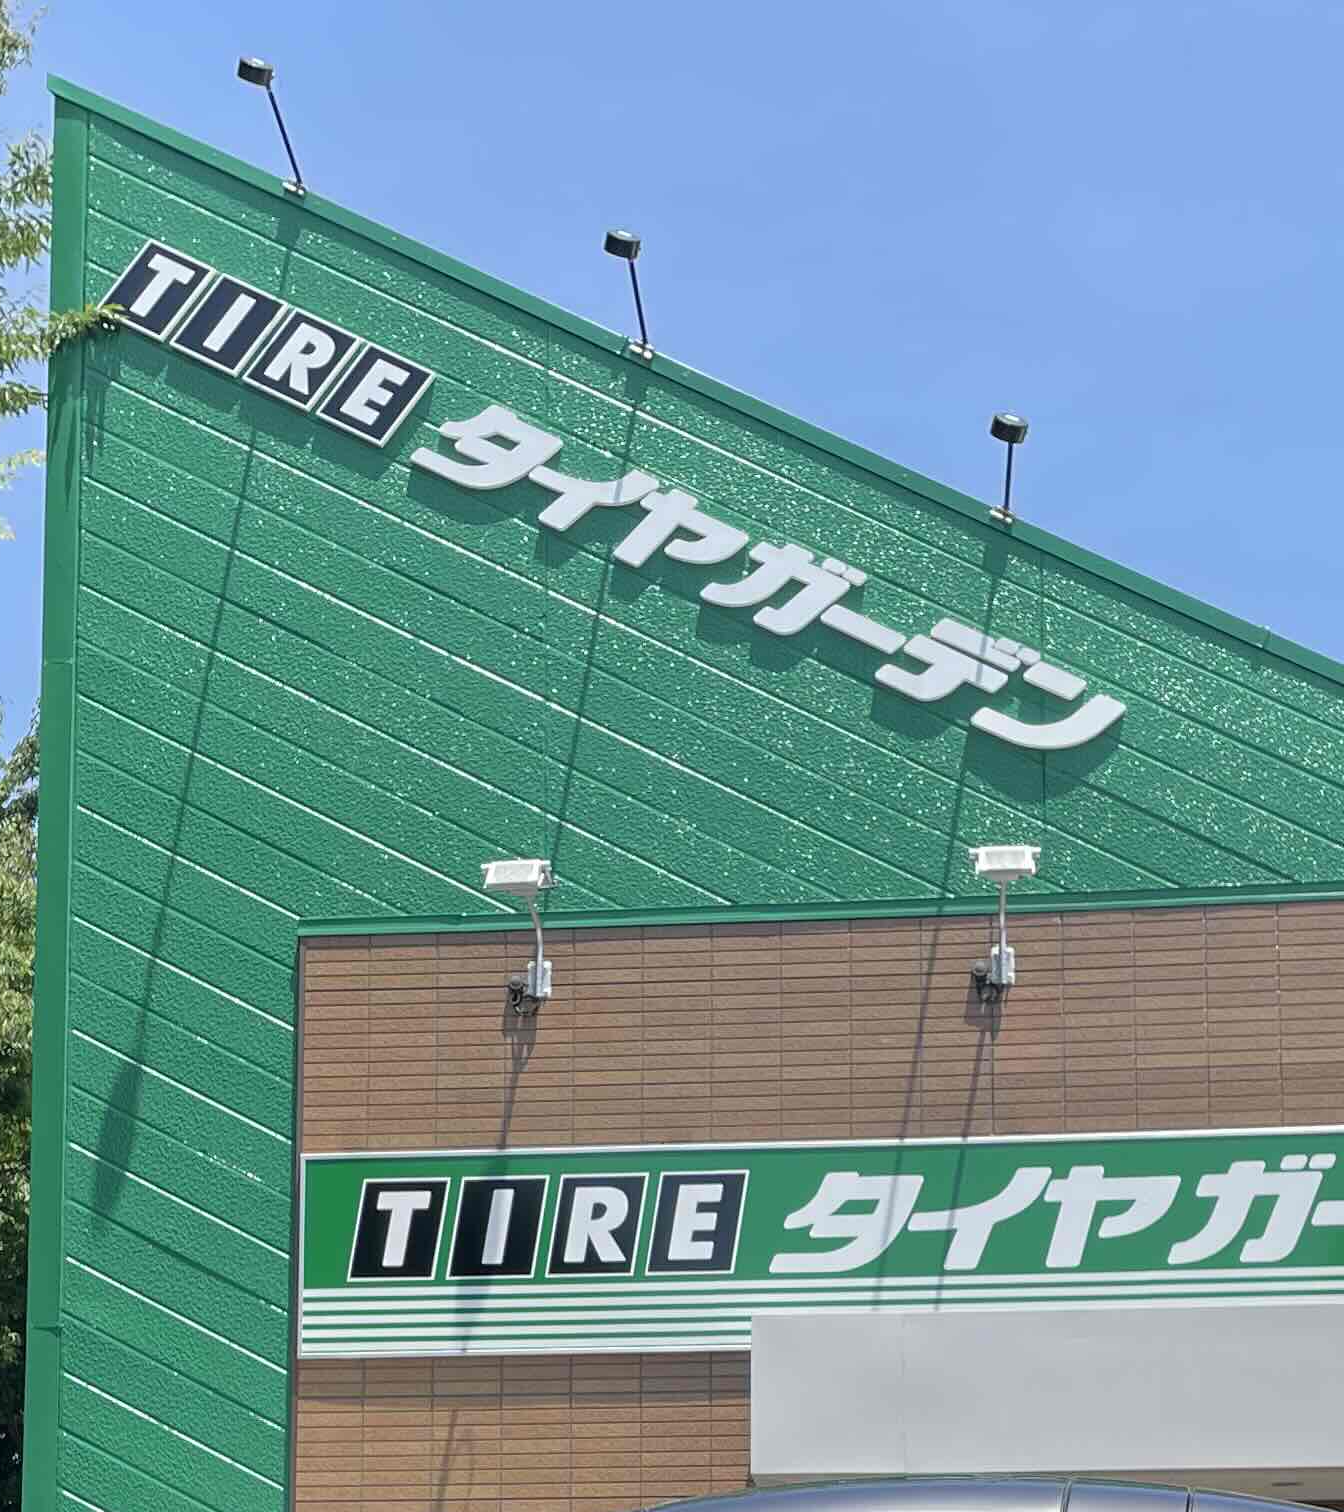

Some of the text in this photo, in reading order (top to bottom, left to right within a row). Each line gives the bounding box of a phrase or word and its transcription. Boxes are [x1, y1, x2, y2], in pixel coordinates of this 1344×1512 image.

[129, 253, 410, 426] TIRE
[410, 403, 1126, 750] タイヤガーデン
[375, 1183, 724, 1268] TIRE
